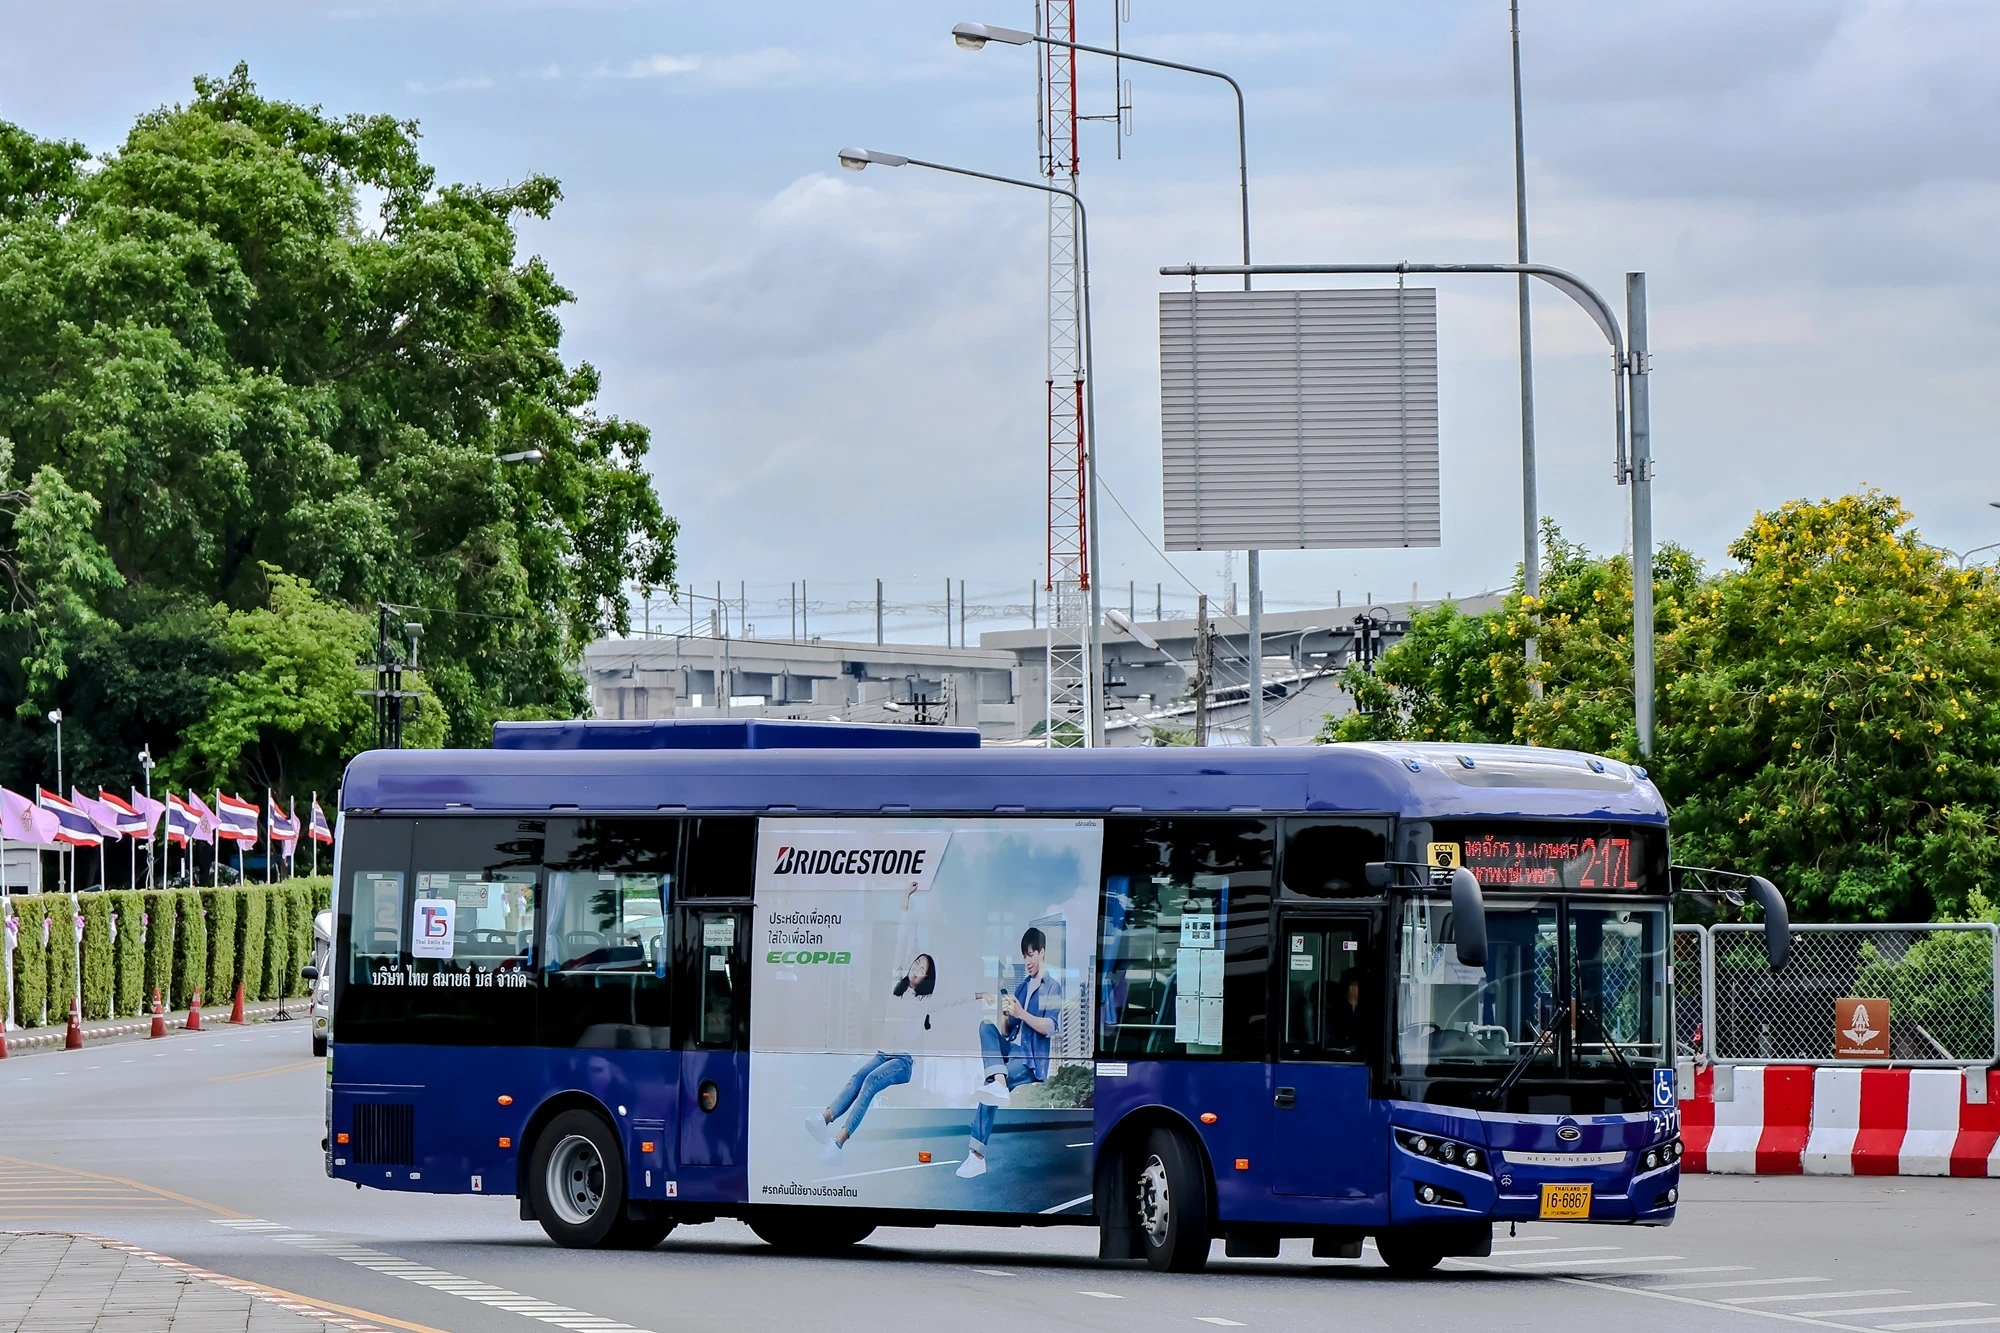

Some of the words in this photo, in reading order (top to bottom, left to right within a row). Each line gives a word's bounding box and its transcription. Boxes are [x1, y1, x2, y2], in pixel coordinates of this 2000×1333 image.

[1433, 844, 1455, 852] CCTV
[773, 846, 927, 875] BRIDGESTONE
[1580, 837, 1638, 888] 2-17L
[769, 908, 842, 929] ประหยัดเพื่อคุณ
[768, 928, 823, 945] ใส่ใจเพื่อโลก
[372, 964, 404, 986] บริษัท
[406, 964, 428, 986] ไทย
[432, 966, 472, 987] สมายล์
[475, 966, 493, 987] บัส
[496, 966, 527, 987] จำกัด
[762, 1180, 858, 1198] #รถคันนี้ใช้ยางบริดจสโตน
[1546, 1192, 1589, 1208] 16-6867
